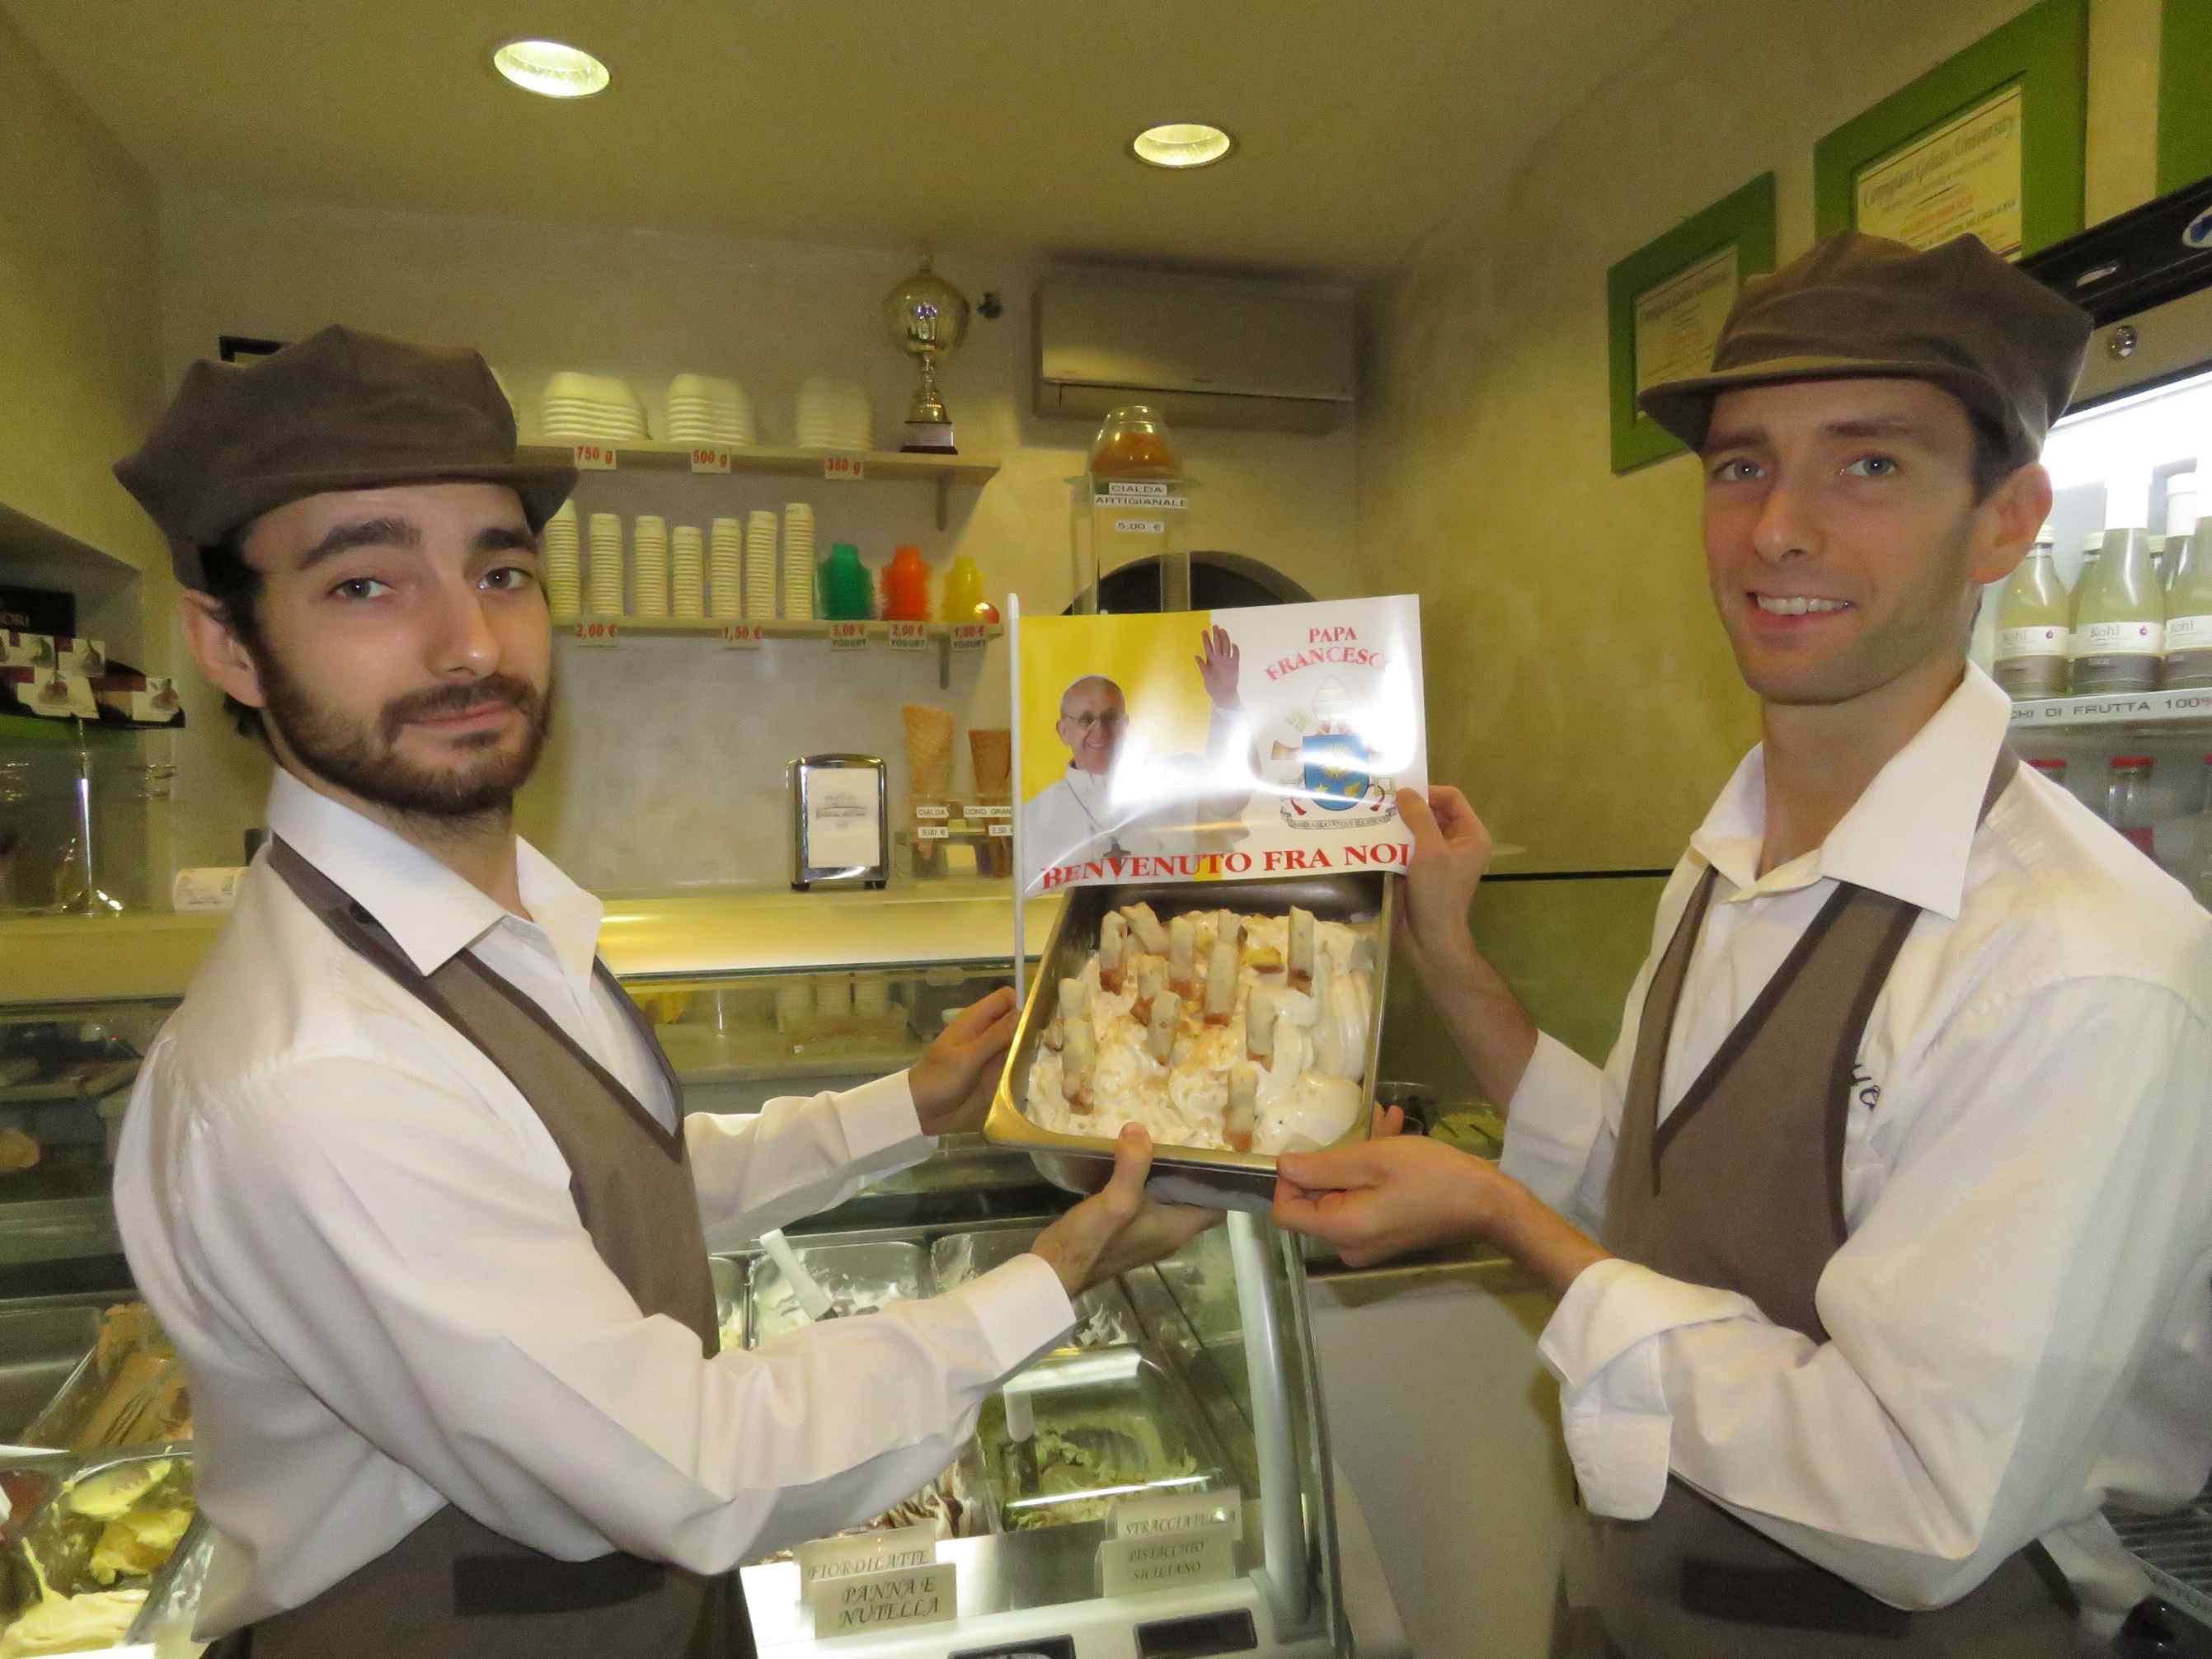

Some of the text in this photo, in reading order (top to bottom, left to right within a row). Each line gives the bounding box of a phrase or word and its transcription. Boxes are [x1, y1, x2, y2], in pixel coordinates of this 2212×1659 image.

[577, 446, 613, 464] 750 g
[693, 449, 728, 468] 500 g
[1111, 485, 1162, 493] CIALDA
[1095, 496, 1187, 507] ARTIGIANALE
[831, 638, 866, 647] YOGURT
[890, 638, 925, 647] YOGURT
[1309, 626, 1357, 643] PAPA
[952, 639, 986, 648] YOGURT
[1265, 646, 1380, 681] FRANCESC
[2045, 707, 2062, 717] DI
[2073, 702, 2151, 716] FRUTTA
[1041, 843, 1410, 891] BENVENUTO FRA NOI
[843, 1577, 915, 1605] PANNA
[838, 1596, 939, 1628] NUTELLA
